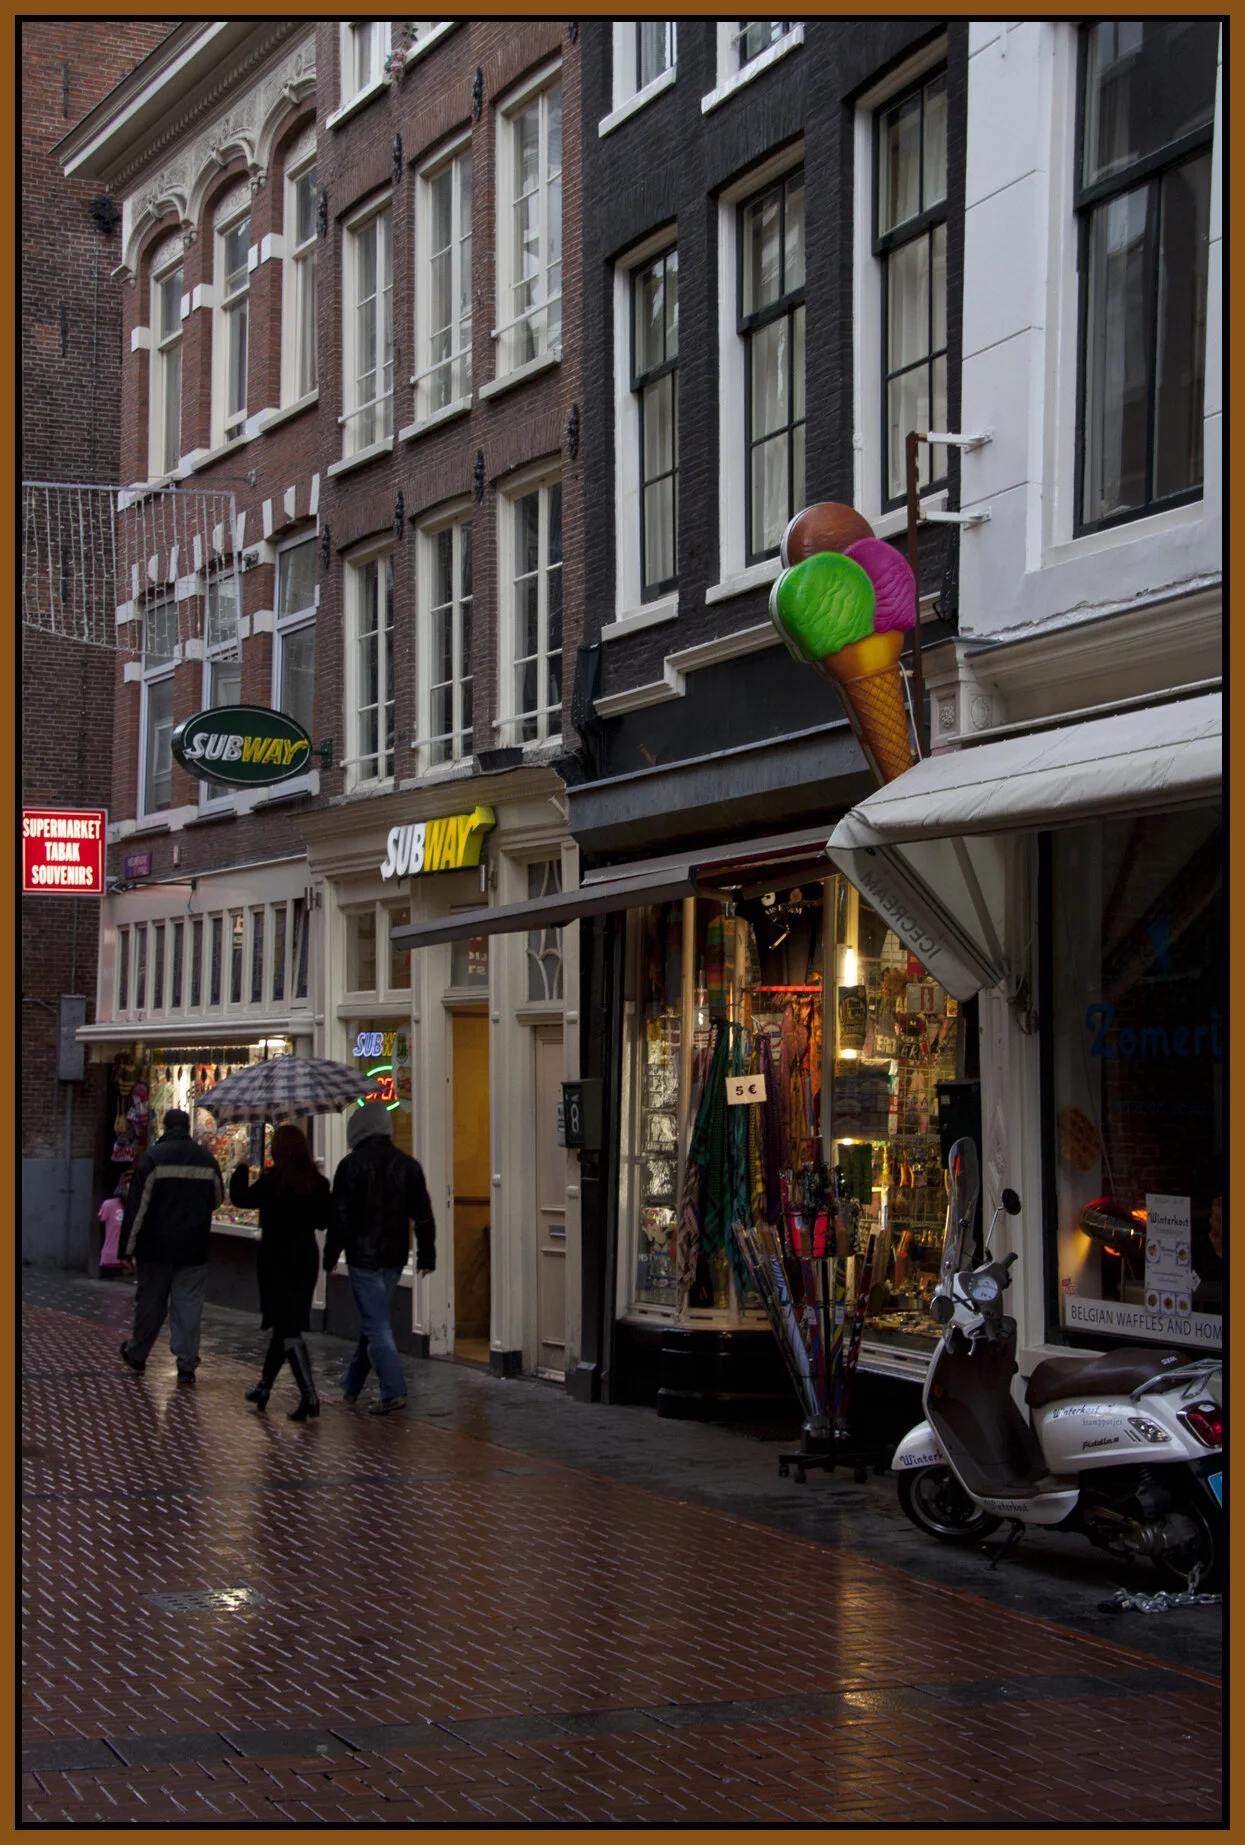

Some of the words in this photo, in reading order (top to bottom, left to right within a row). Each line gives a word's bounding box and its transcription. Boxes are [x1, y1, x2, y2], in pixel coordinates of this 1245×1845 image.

[182, 732, 310, 765] SUBWAY
[22, 817, 102, 839] SUPERMARKET
[44, 841, 80, 862] TABAK
[380, 806, 488, 882] SUBWAY
[31, 865, 94, 886] SOUVENIRS
[735, 1086, 744, 1096] 5
[748, 1084, 757, 1095] €
[1147, 1211, 1189, 1228] Winterkost
[1071, 1305, 1113, 1325] BELGIAN
[1116, 1311, 1163, 1332] WAFFLES
[1167, 1319, 1191, 1336] AND
[1051, 1402, 1100, 1420] Winterkost
